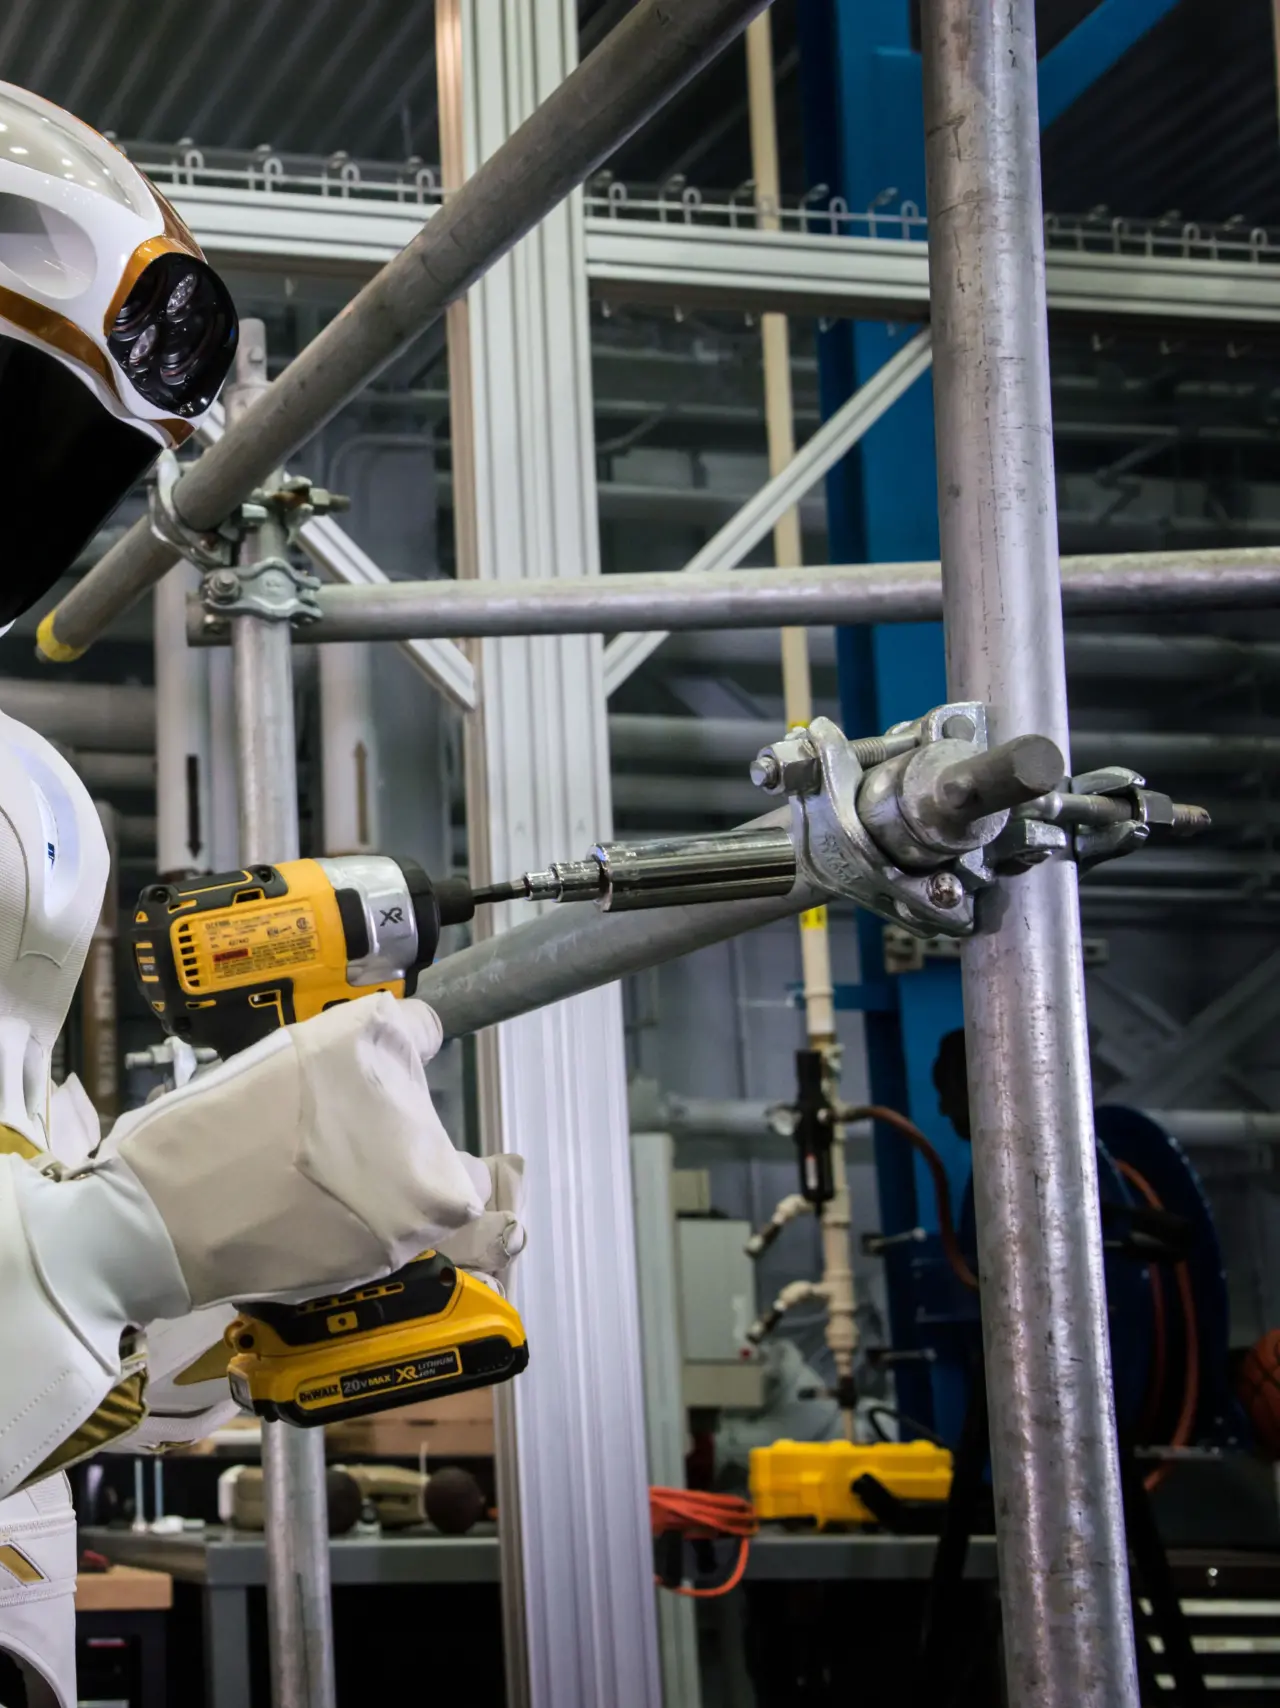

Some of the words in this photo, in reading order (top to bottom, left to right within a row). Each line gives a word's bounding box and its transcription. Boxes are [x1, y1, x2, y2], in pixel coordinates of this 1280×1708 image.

[379, 906, 404, 927] XR
[395, 1365, 417, 1383] XR
[418, 1355, 454, 1370] LITHIUM
